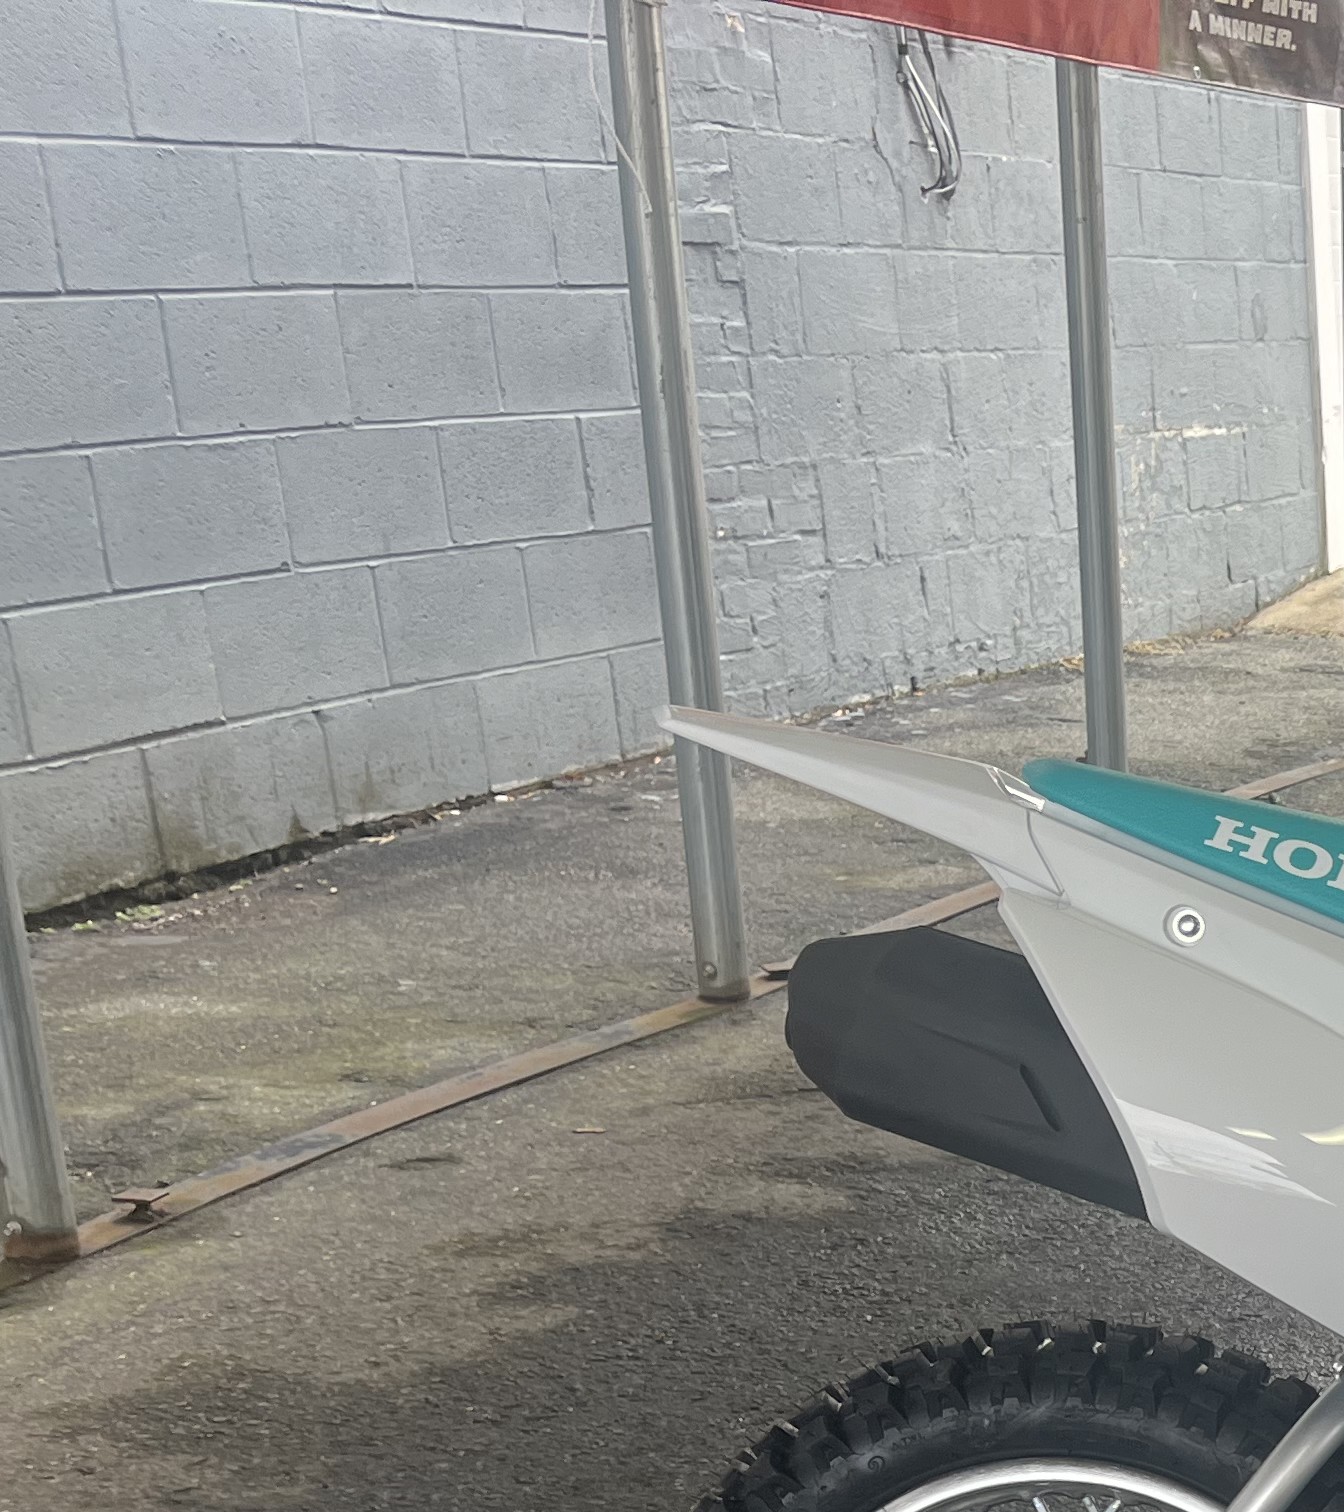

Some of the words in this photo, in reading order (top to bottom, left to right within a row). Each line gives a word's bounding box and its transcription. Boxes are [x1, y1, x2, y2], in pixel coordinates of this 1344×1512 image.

[1262, 0, 1317, 23] WITH
[1189, 9, 1202, 32] A
[1208, 13, 1297, 52] WINNER.
